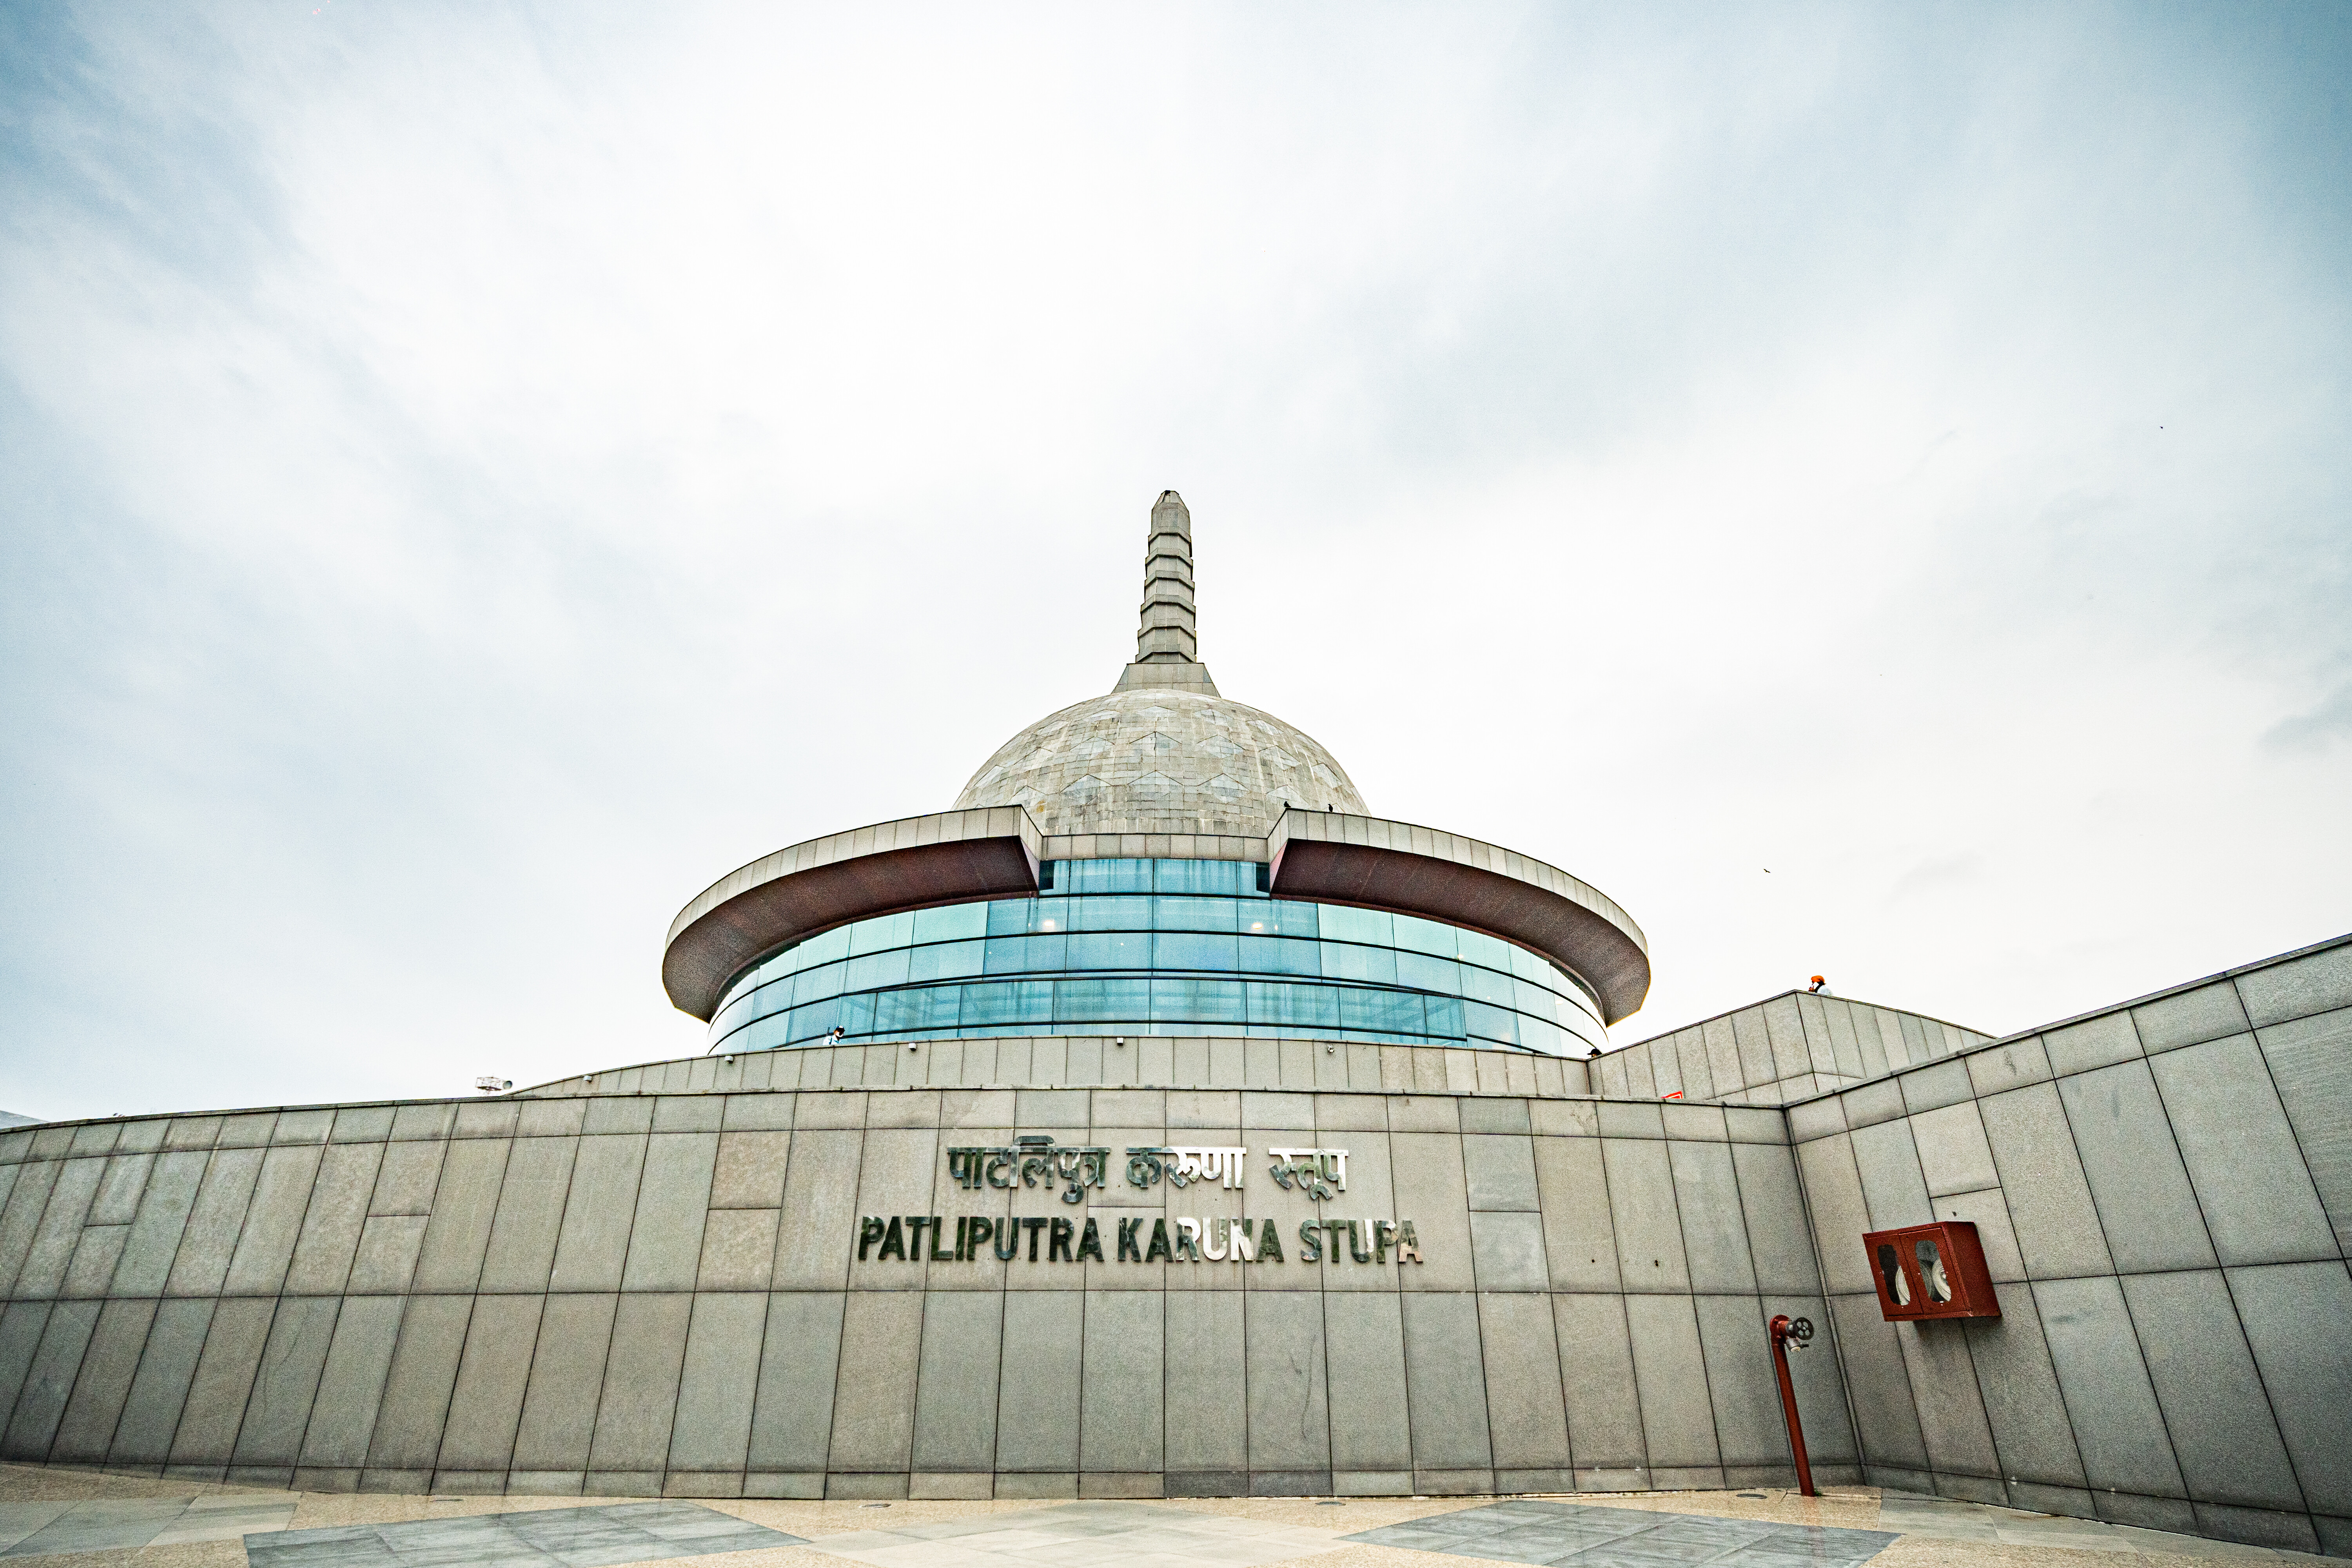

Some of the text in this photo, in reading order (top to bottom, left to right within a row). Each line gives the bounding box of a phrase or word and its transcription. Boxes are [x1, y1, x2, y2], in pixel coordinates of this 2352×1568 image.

[947, 1135, 1110, 1203] पाटलिपुत्र
[1269, 1147, 1349, 1200] स्तूप
[858, 1216, 1423, 1263] PATLIPUTRA KARUNA STUPA
